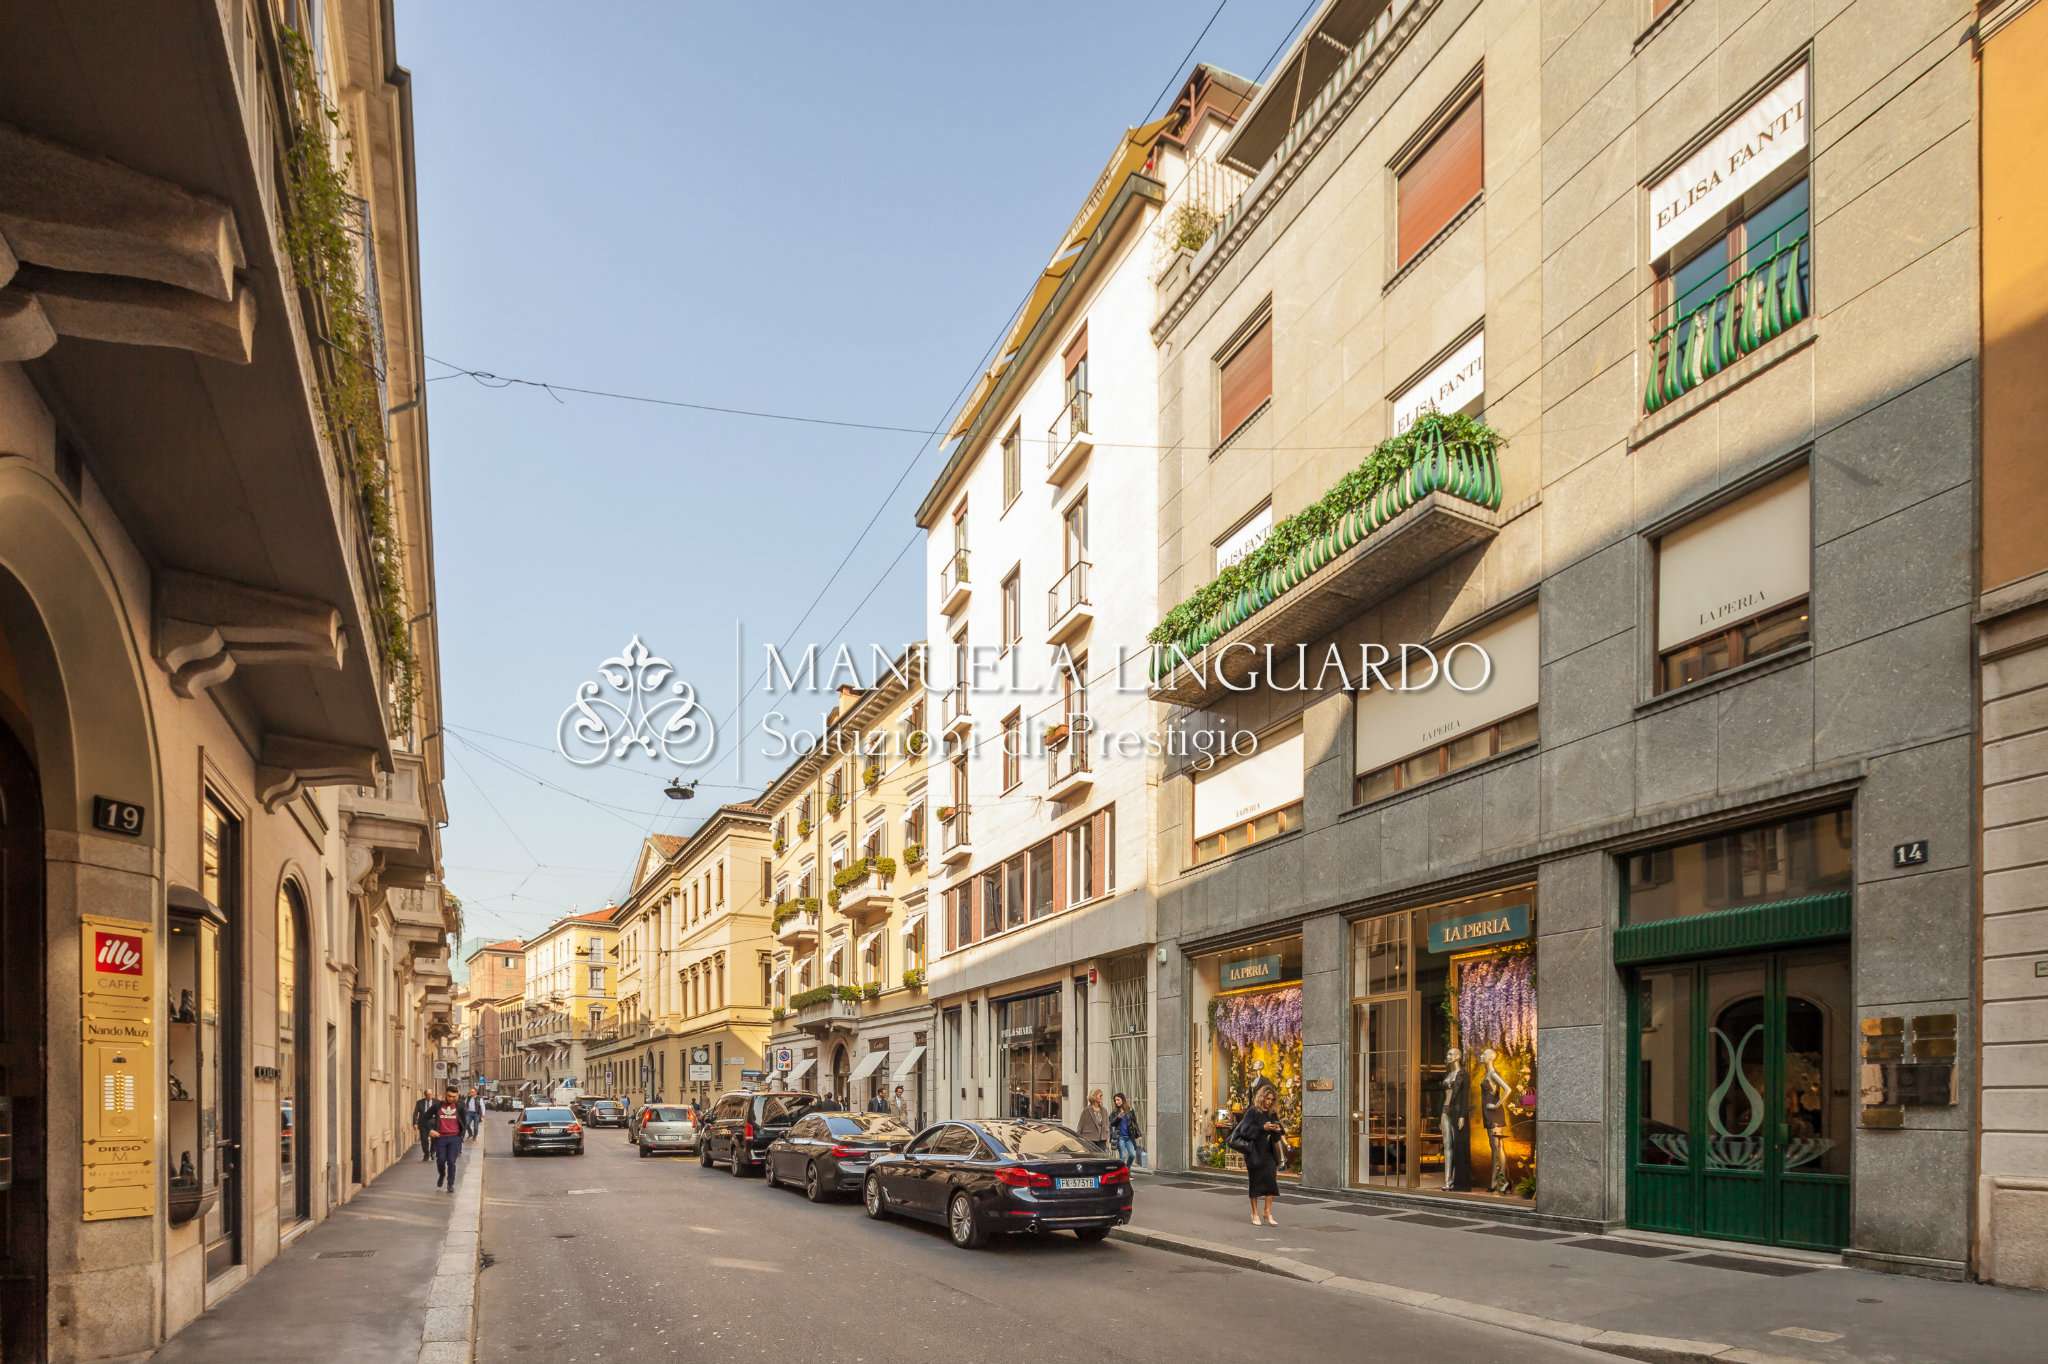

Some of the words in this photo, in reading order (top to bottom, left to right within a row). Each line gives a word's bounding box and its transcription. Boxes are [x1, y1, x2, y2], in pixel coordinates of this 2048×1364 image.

[1656, 171, 1722, 230] ELISA
[1728, 99, 1805, 177] FANTI
[1398, 396, 1440, 432] ELISA
[1440, 356, 1482, 401] FANTI
[107, 803, 139, 829] 19
[1897, 843, 1922, 863] 14
[98, 939, 140, 971] illy
[88, 1024, 123, 1036] Nando
[125, 1026, 149, 1037] Muzi
[98, 1145, 141, 1153] DIEGO
